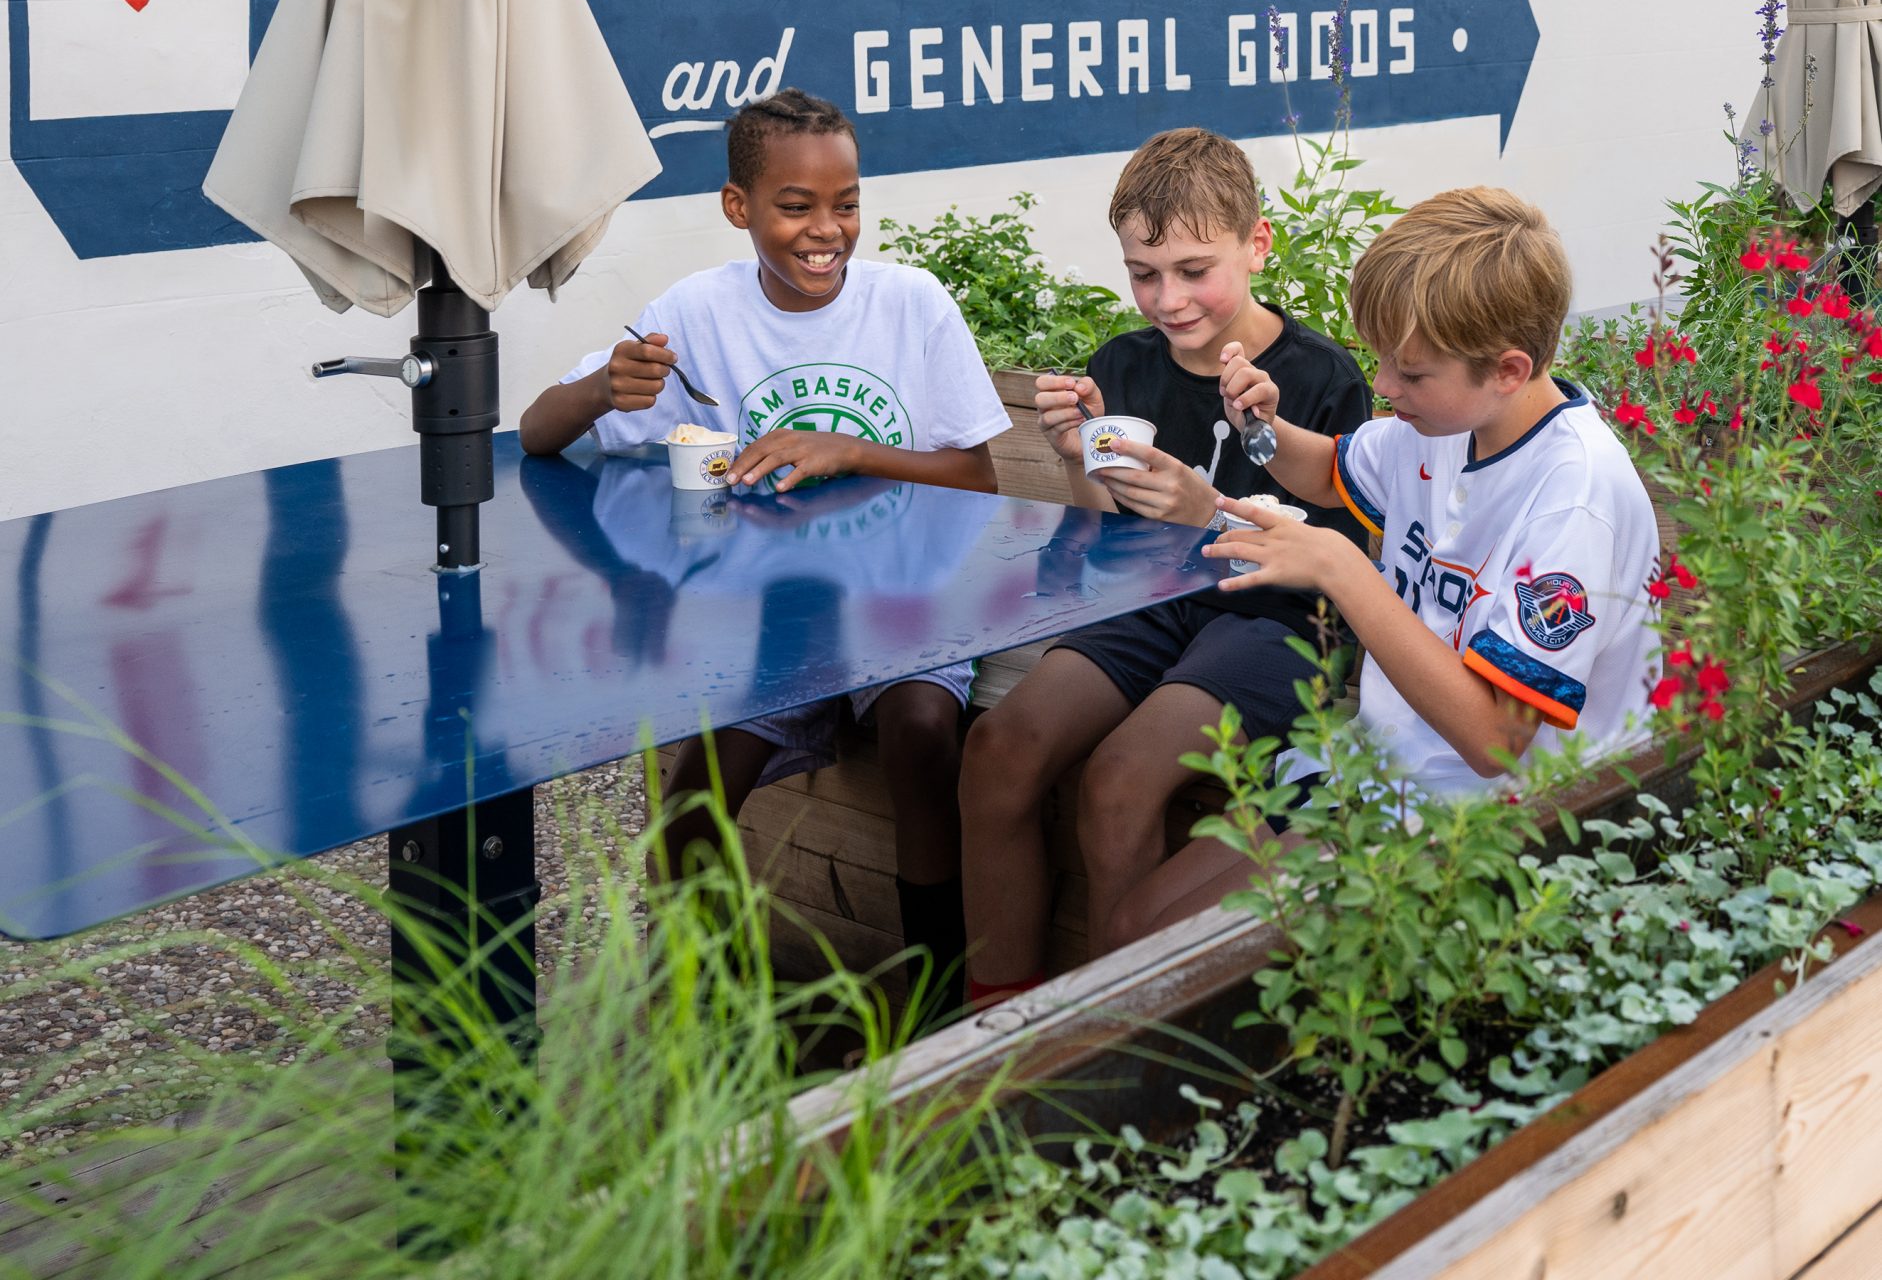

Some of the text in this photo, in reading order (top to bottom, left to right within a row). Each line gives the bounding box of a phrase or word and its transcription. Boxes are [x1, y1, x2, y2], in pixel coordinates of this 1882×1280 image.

[662, 8, 1415, 113] and GENERAL GOODS
[745, 376, 903, 447] HAM BASKETB
[1546, 579, 1579, 596] HOUSTO
[1549, 634, 1567, 644] CITY
